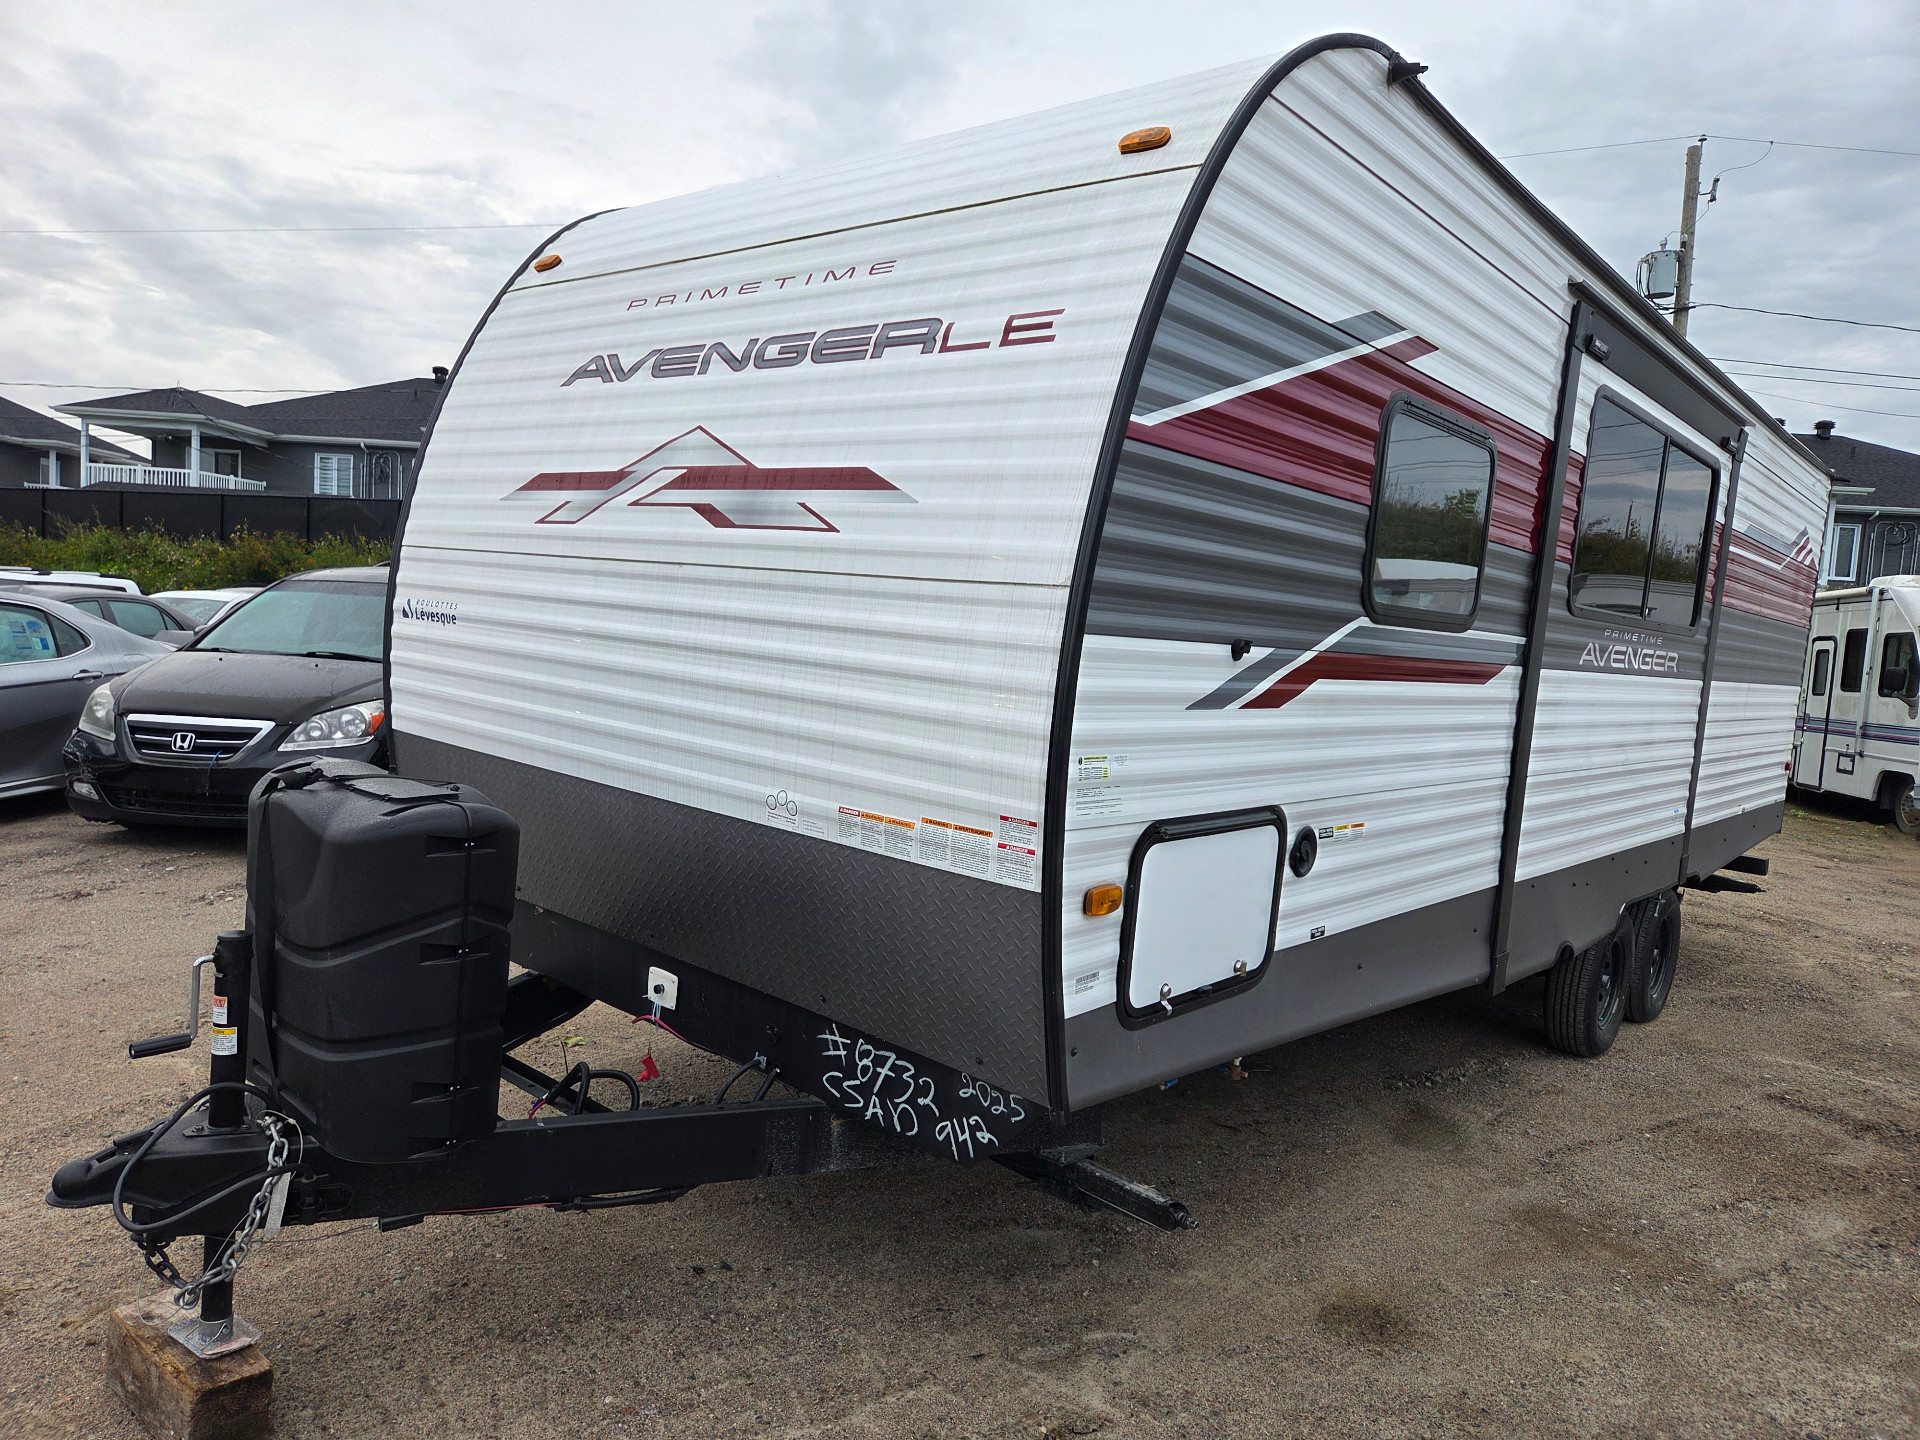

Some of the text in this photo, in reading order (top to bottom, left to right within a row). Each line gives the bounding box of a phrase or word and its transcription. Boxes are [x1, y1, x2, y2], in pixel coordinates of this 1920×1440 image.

[626, 259, 898, 311] PRIMETIME
[560, 317, 944, 387] AVENGER
[415, 607, 457, 626] Lévesque
[416, 599, 458, 610] ROULOTTES
[1604, 629, 1664, 645] PRIMETIME
[1579, 642, 1679, 673] AVENGER
[958, 1072, 1026, 1123] 2025
[935, 1115, 999, 1161] 942
